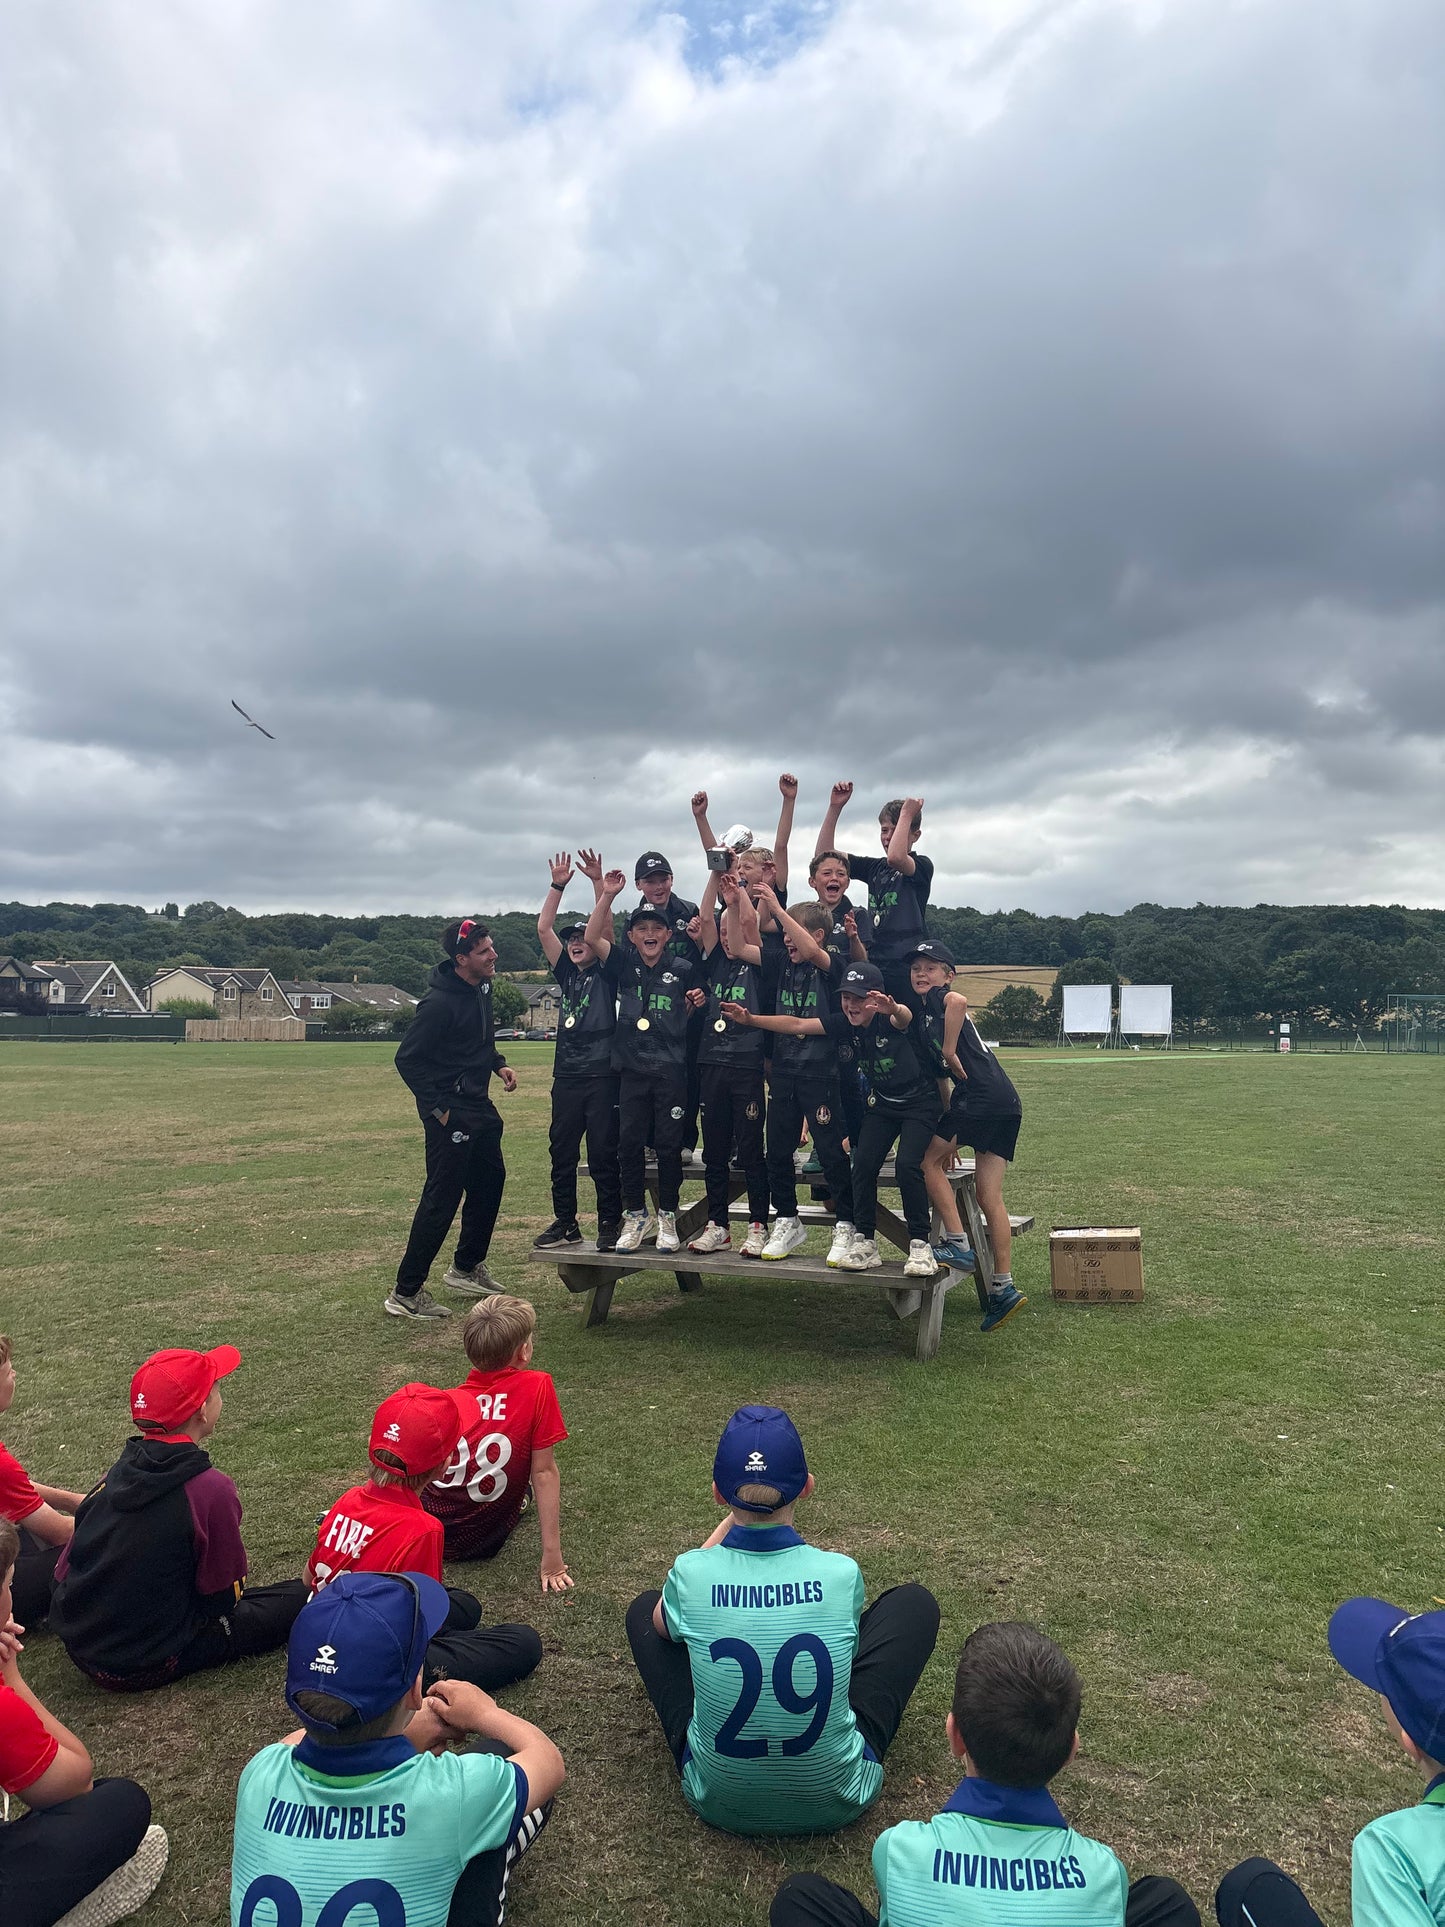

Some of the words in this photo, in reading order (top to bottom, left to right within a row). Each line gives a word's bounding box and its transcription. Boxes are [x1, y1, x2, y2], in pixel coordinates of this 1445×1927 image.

[475, 1393, 508, 1421] RE
[324, 1513, 375, 1559] FIRE
[711, 1580, 823, 1609] INVINCIBLES
[309, 1661, 339, 1675] SHREY
[708, 1632, 834, 1760] 29
[262, 1796, 406, 1840] INVINCIBLES
[933, 1848, 1087, 1892] INVINCIBLES
